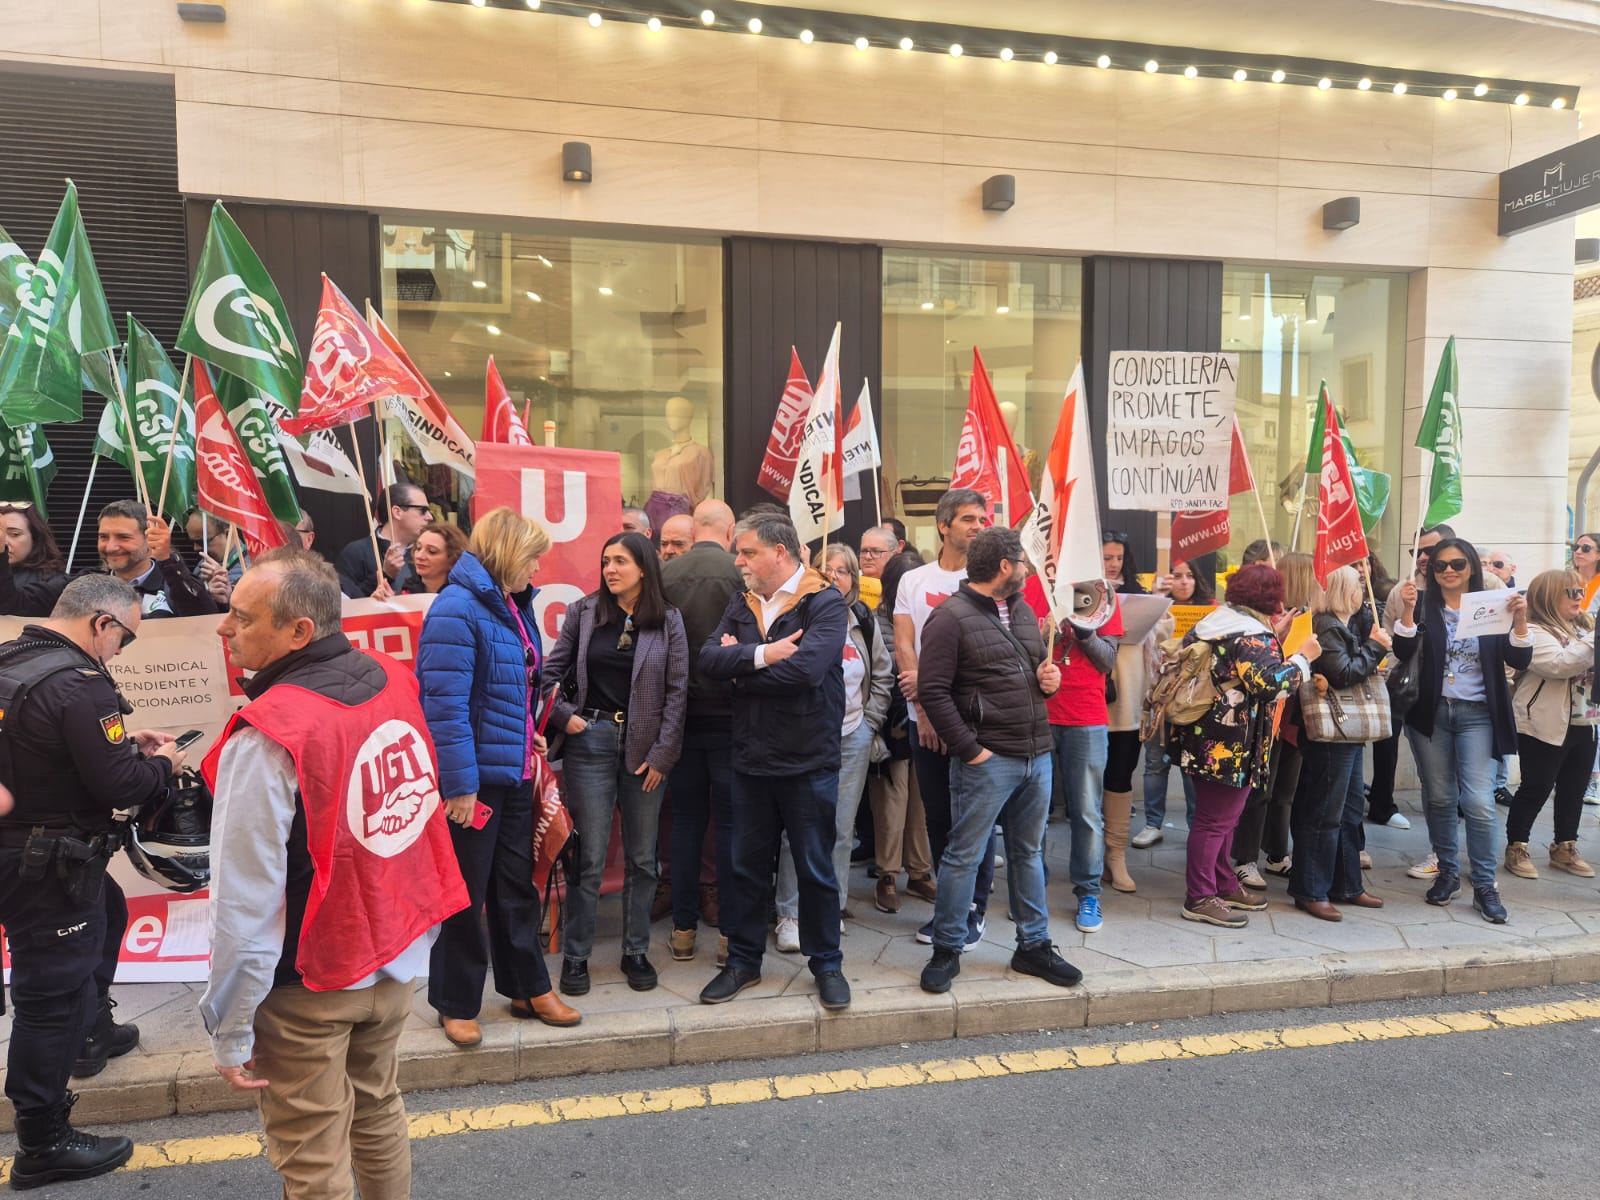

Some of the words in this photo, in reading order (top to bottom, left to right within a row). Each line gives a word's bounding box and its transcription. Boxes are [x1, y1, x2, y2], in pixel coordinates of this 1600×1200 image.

[1112, 389, 1226, 428] PROMETE,
[1113, 422, 1205, 459] IMPAGOS
[1112, 463, 1218, 496] CONTINÚAN
[144, 660, 208, 674] SINDICAL
[201, 678, 209, 687] Y
[361, 732, 423, 816] UGT
